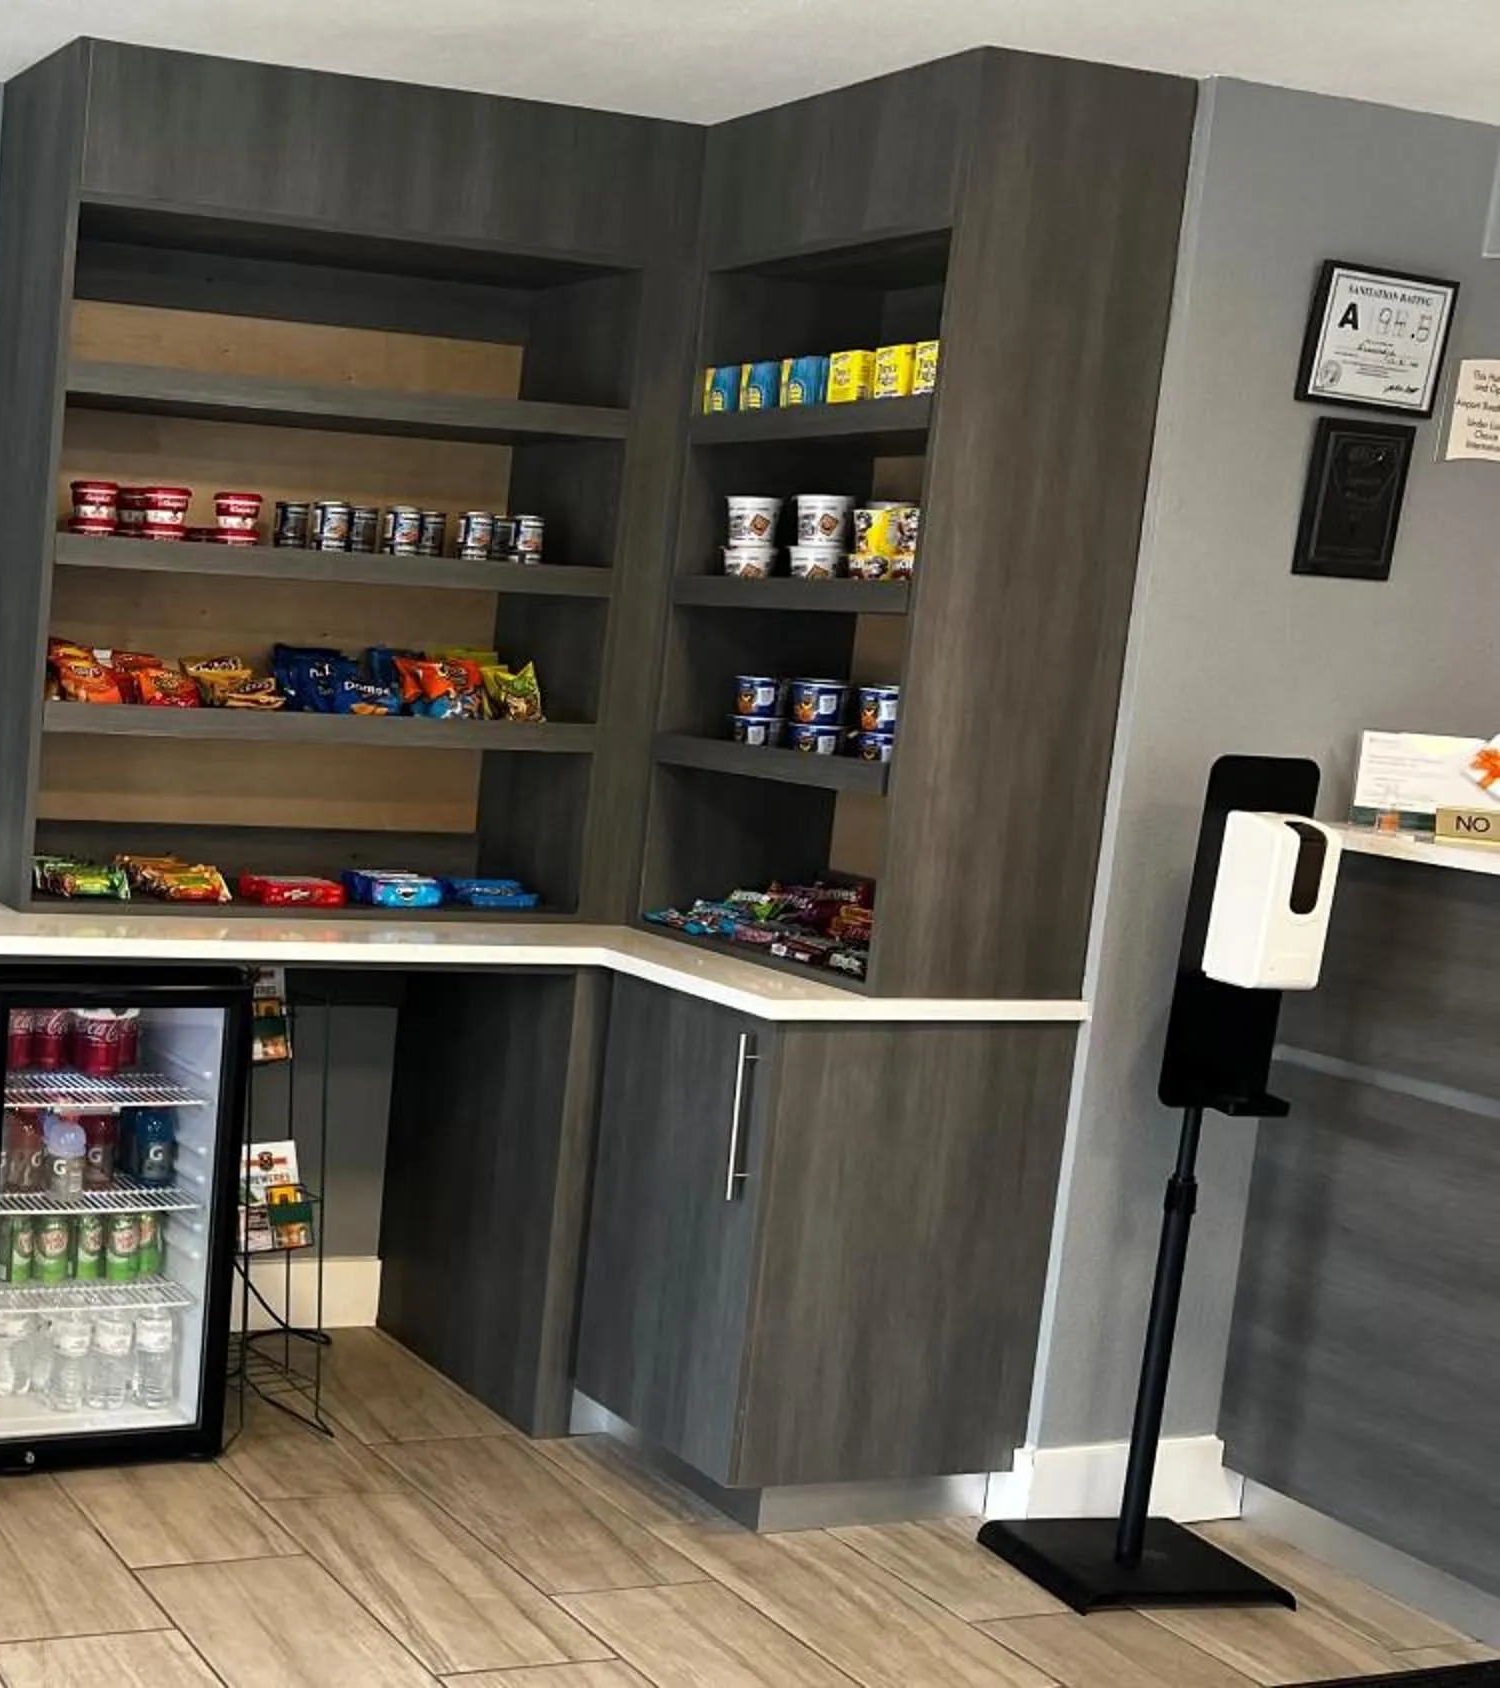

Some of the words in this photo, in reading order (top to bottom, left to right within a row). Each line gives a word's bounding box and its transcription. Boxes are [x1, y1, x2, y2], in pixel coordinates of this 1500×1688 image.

[1349, 284, 1398, 300] SANITATION
[1399, 293, 1433, 306] RATING
[1338, 302, 1359, 331] A
[1455, 815, 1491, 833] NO
[53, 1159, 67, 1176] G
